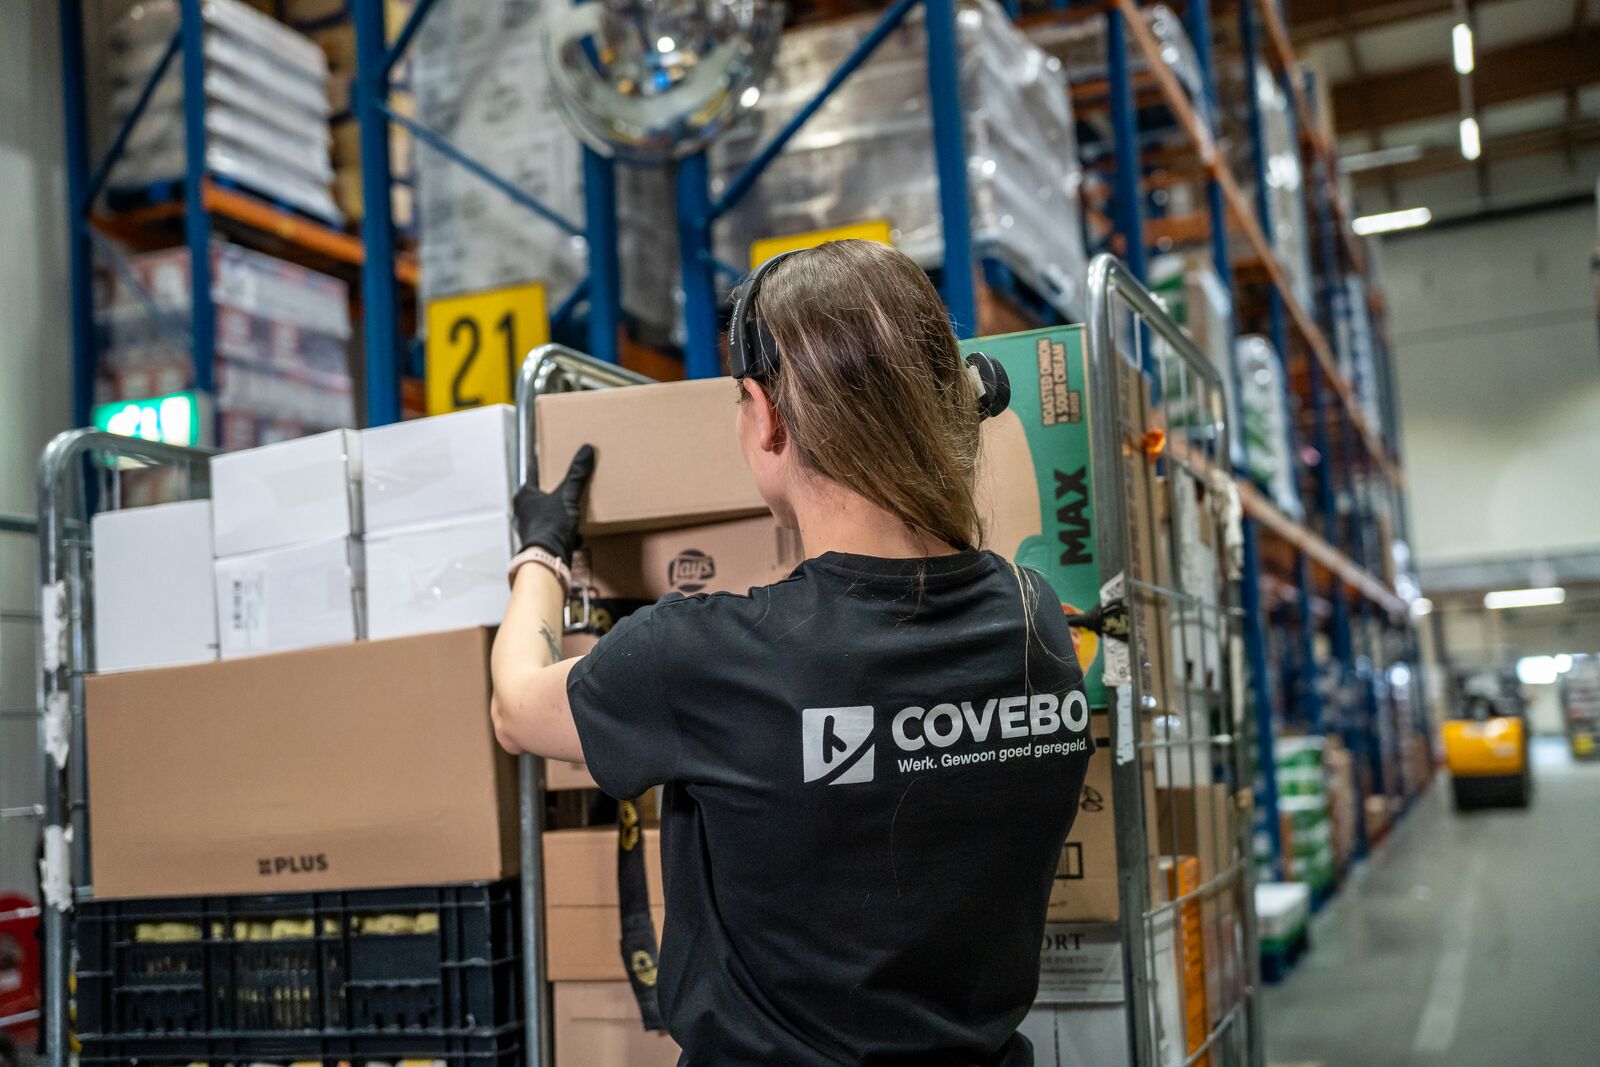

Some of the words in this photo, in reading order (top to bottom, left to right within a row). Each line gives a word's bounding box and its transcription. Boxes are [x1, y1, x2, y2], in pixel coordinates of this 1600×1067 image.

[449, 311, 516, 407] 21
[1054, 466, 1092, 566] MAX
[891, 690, 1088, 751] COVEBO
[898, 755, 937, 773] Werk.
[941, 751, 995, 768] Gewoon
[999, 741, 1031, 762] goed
[1035, 738, 1087, 757] geregeld.
